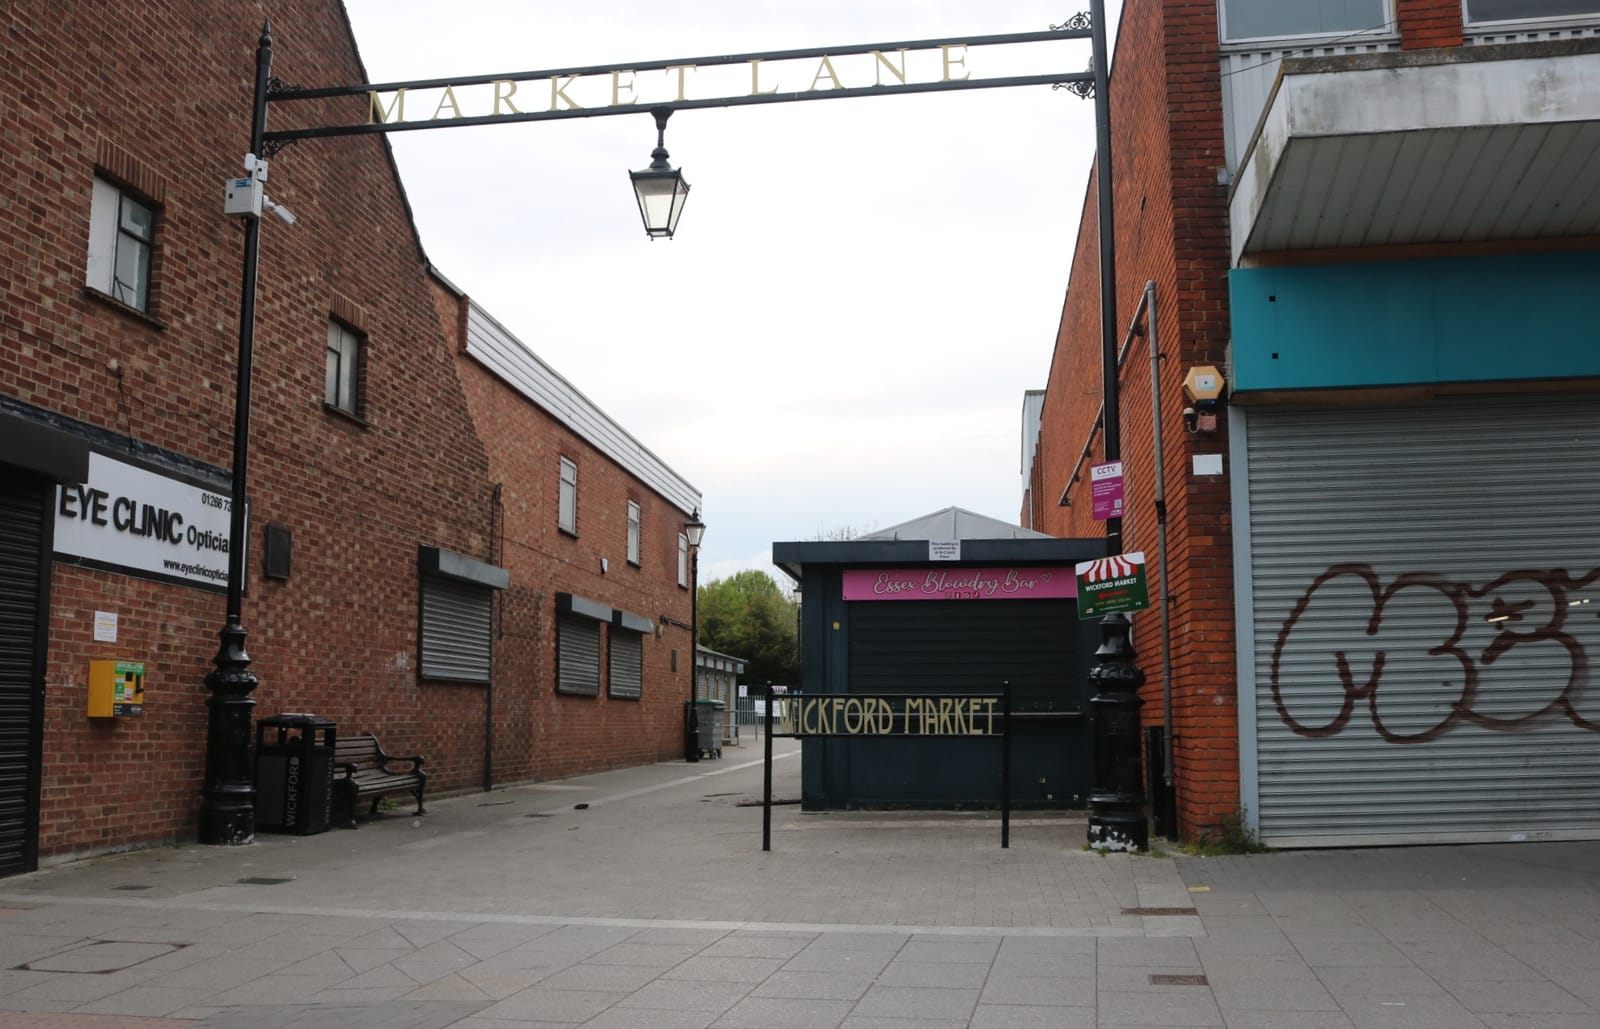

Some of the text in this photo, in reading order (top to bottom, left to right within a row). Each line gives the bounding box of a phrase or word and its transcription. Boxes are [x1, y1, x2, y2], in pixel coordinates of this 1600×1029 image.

[366, 44, 971, 125] MARKET LANE
[1096, 465, 1117, 475] CCTV
[60, 484, 230, 553] EYE CLINIC Opticia
[163, 559, 230, 581] www.eyeclinicopticia
[873, 569, 1039, 595] Essex Blowdry Bar
[1085, 577, 1137, 592] WICKFORD MARKET
[778, 698, 894, 735] WICKFORD
[904, 698, 998, 735] MARKET
[286, 756, 301, 827] WICKFORD
